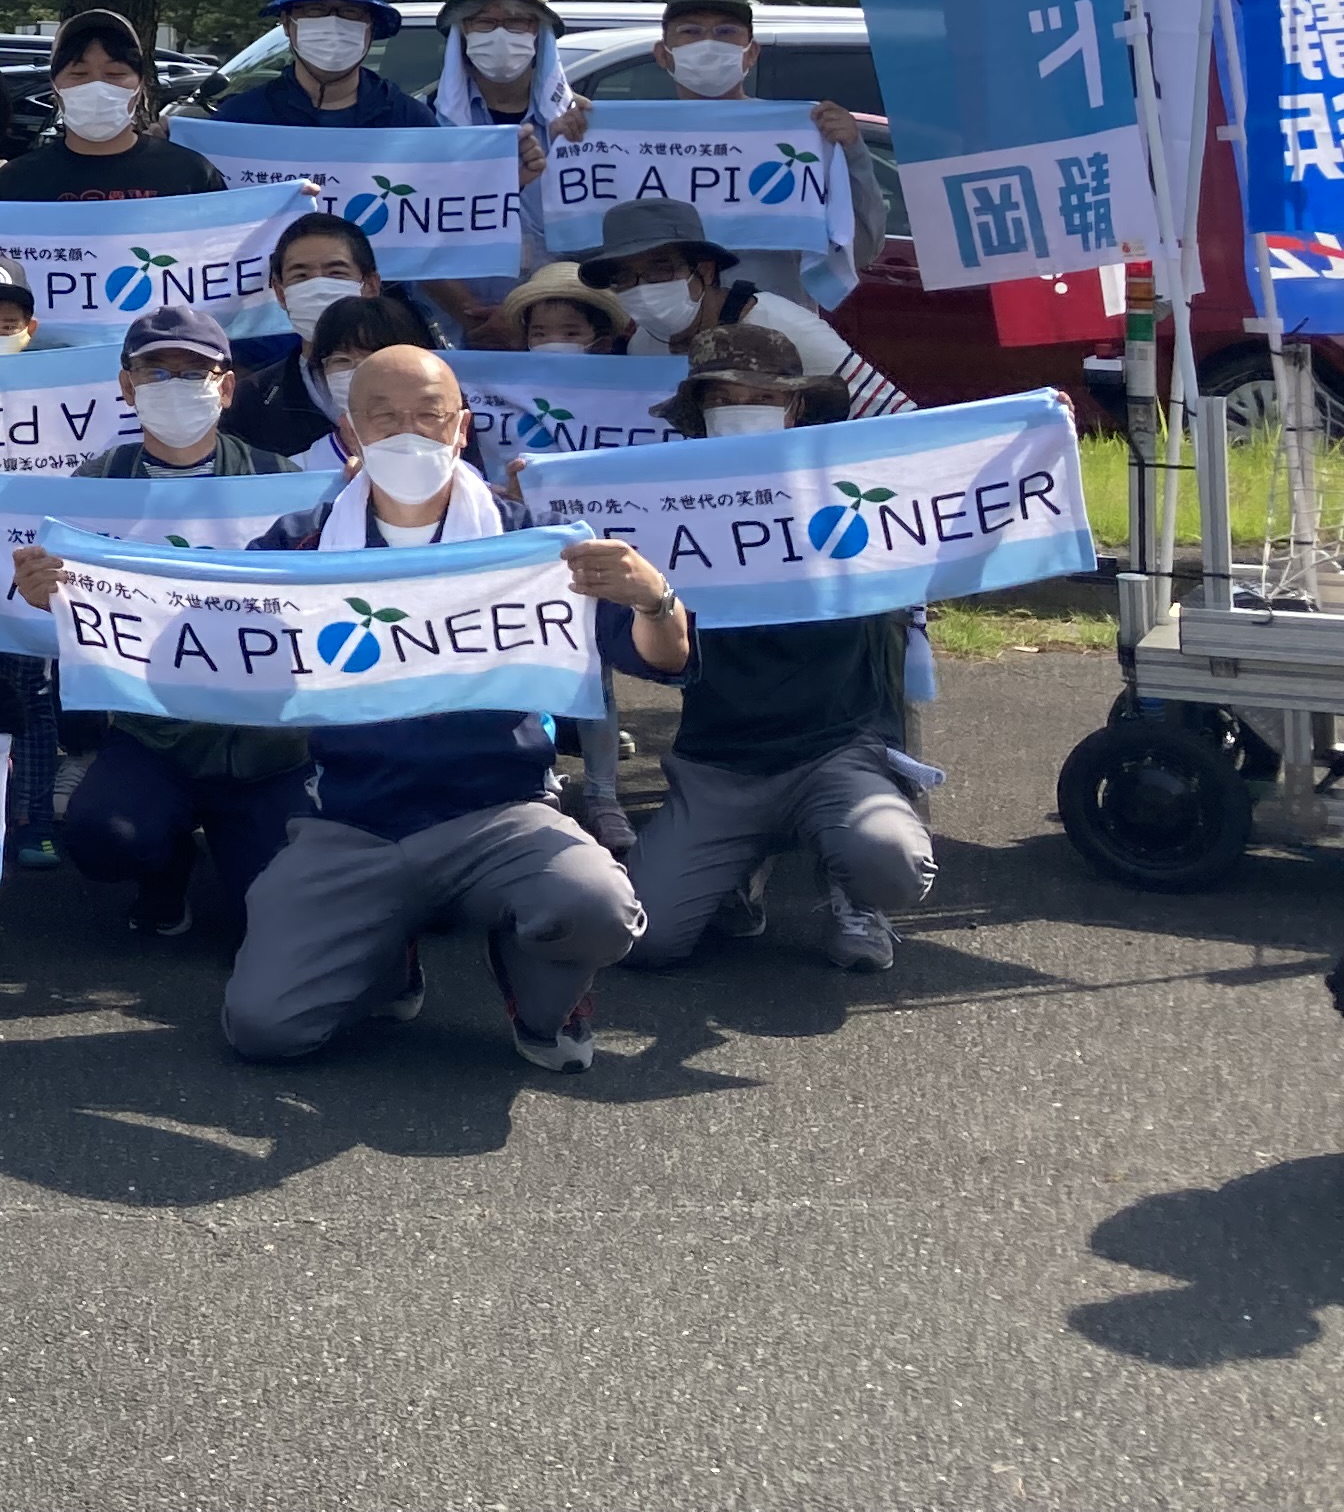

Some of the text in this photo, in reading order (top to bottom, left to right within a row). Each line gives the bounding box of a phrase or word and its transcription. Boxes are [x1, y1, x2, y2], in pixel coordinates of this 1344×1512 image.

[559, 164, 618, 206] BE
[635, 165, 669, 200] A
[59, 398, 97, 442] A
[668, 524, 713, 571] A
[70, 600, 151, 664] BE
[174, 622, 219, 674] A
